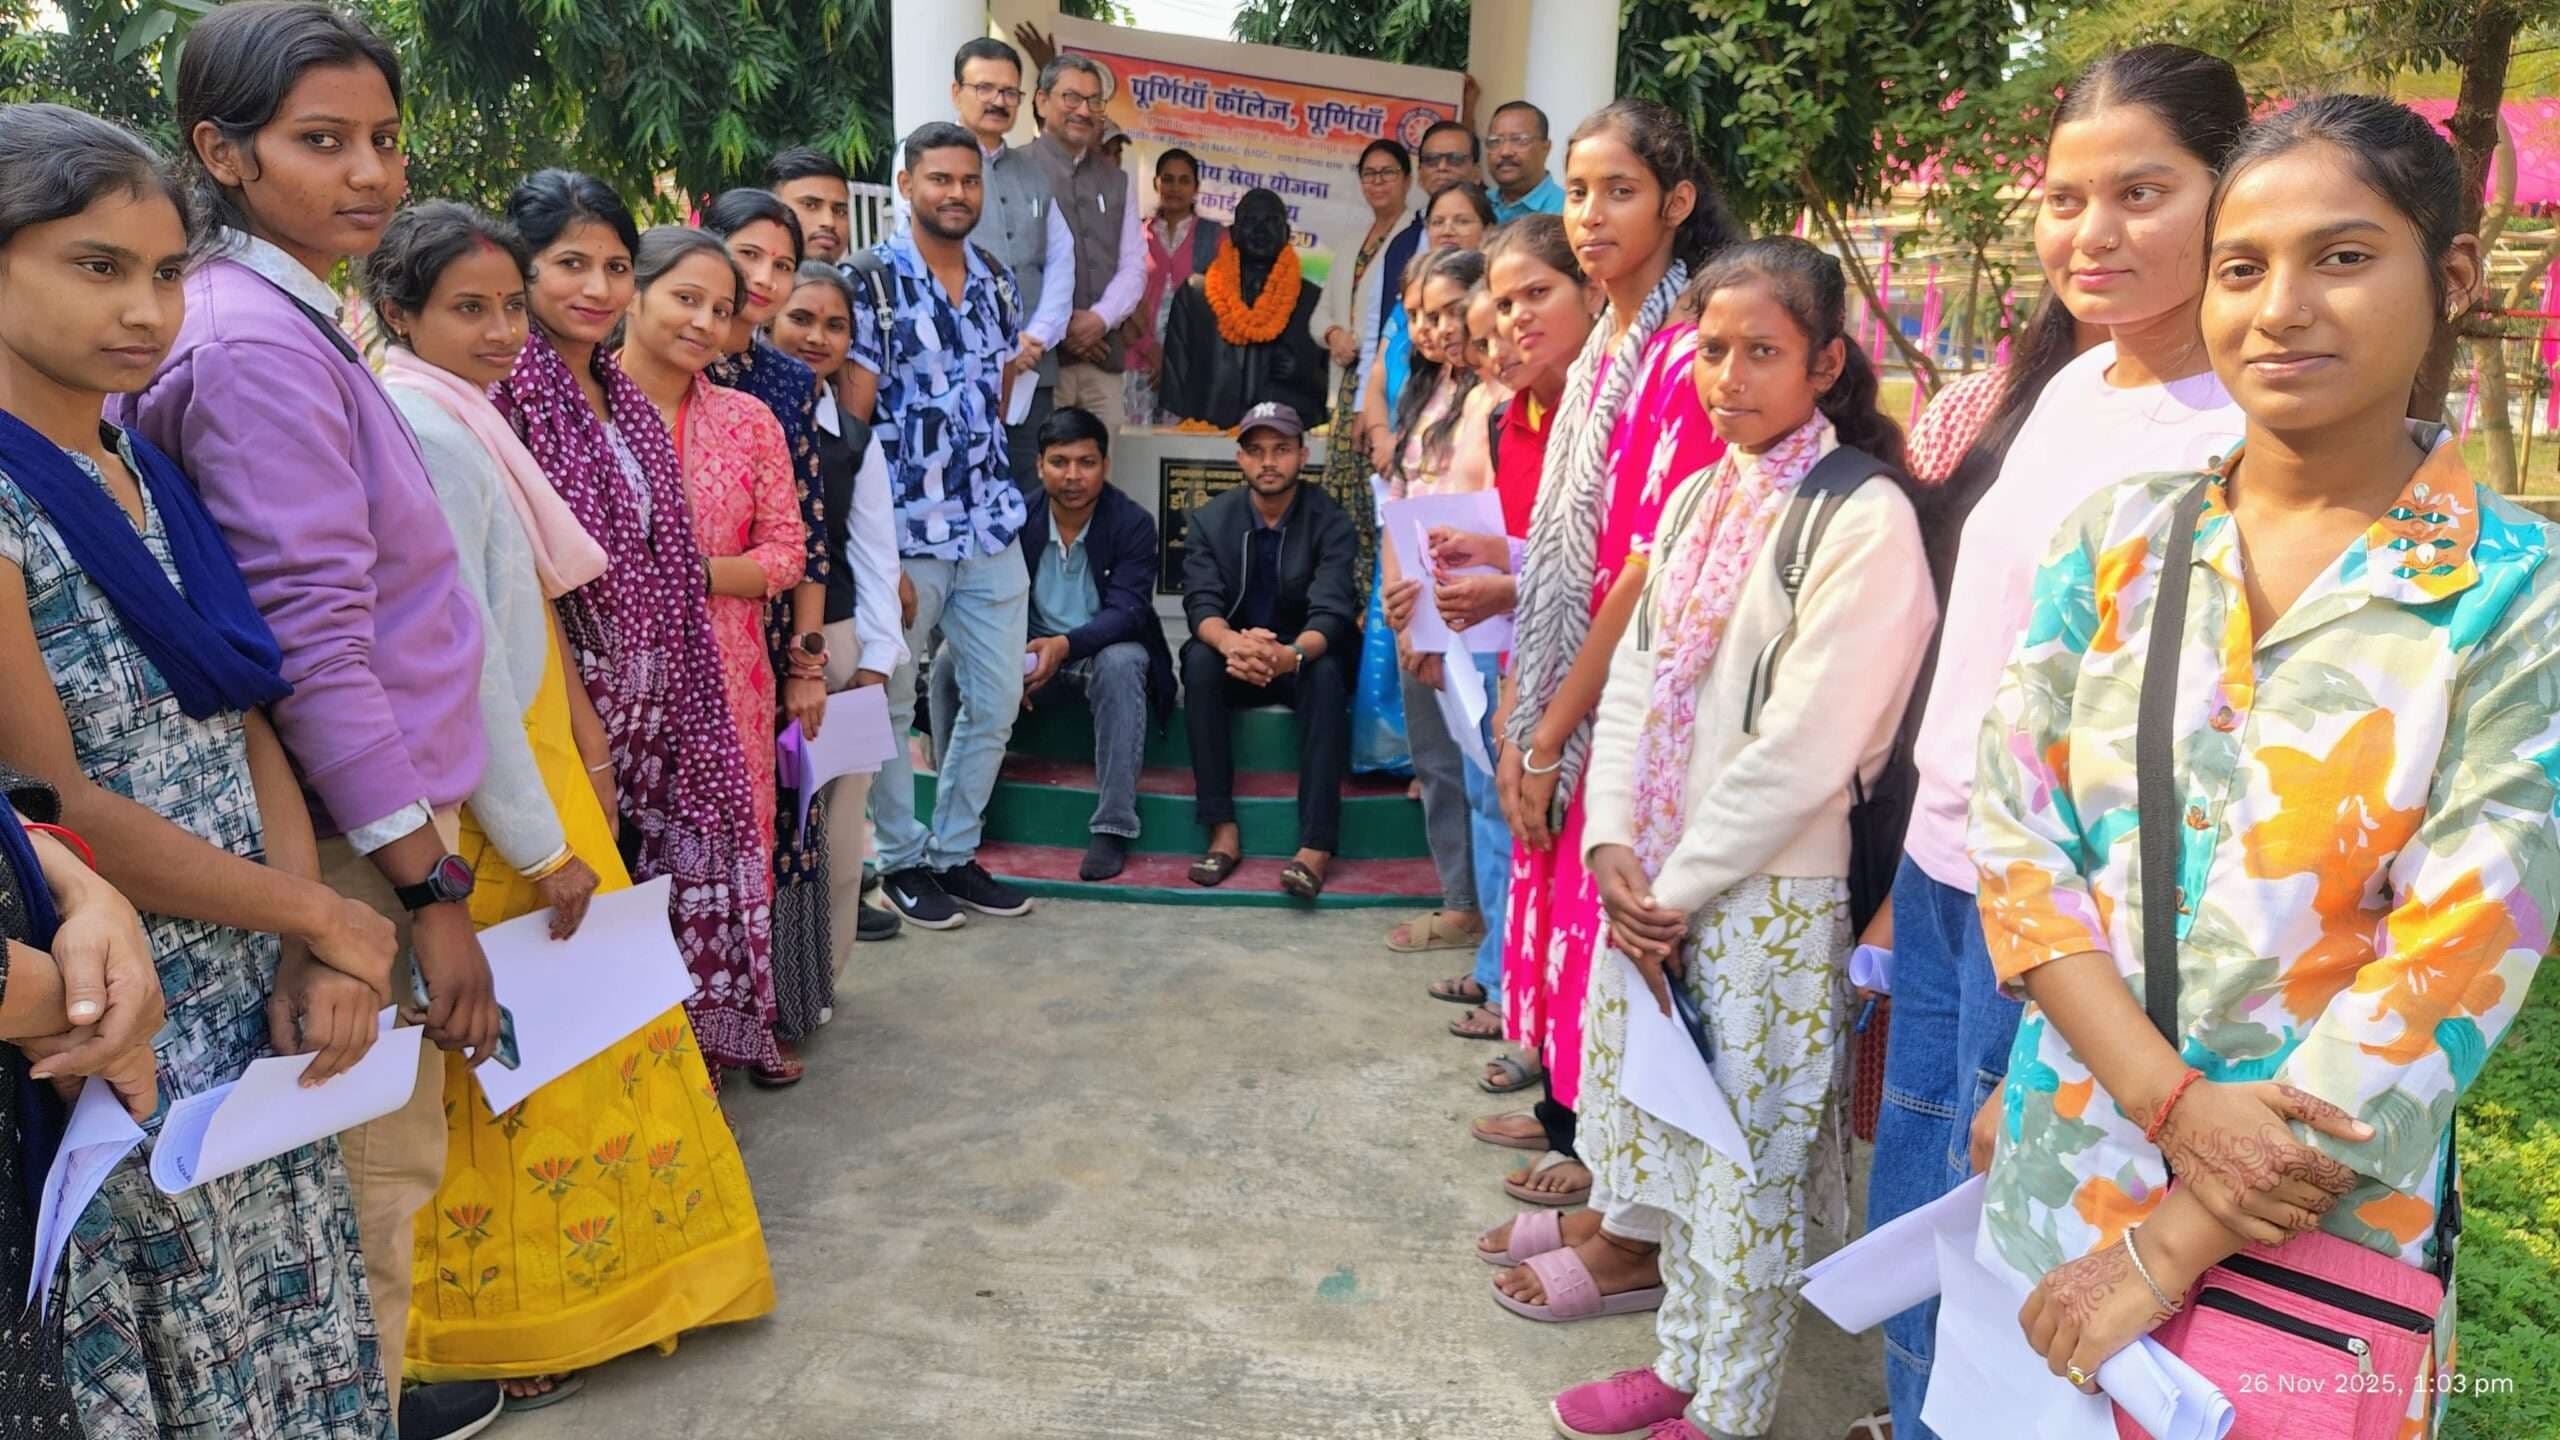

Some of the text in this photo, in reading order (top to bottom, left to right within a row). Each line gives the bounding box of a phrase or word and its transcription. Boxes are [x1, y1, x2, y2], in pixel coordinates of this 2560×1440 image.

[1213, 88, 1295, 127] कॉलेज,
[1228, 164, 1263, 188] सेवा
[1269, 172, 1330, 199] योजना
[1199, 191, 1237, 213] काई
